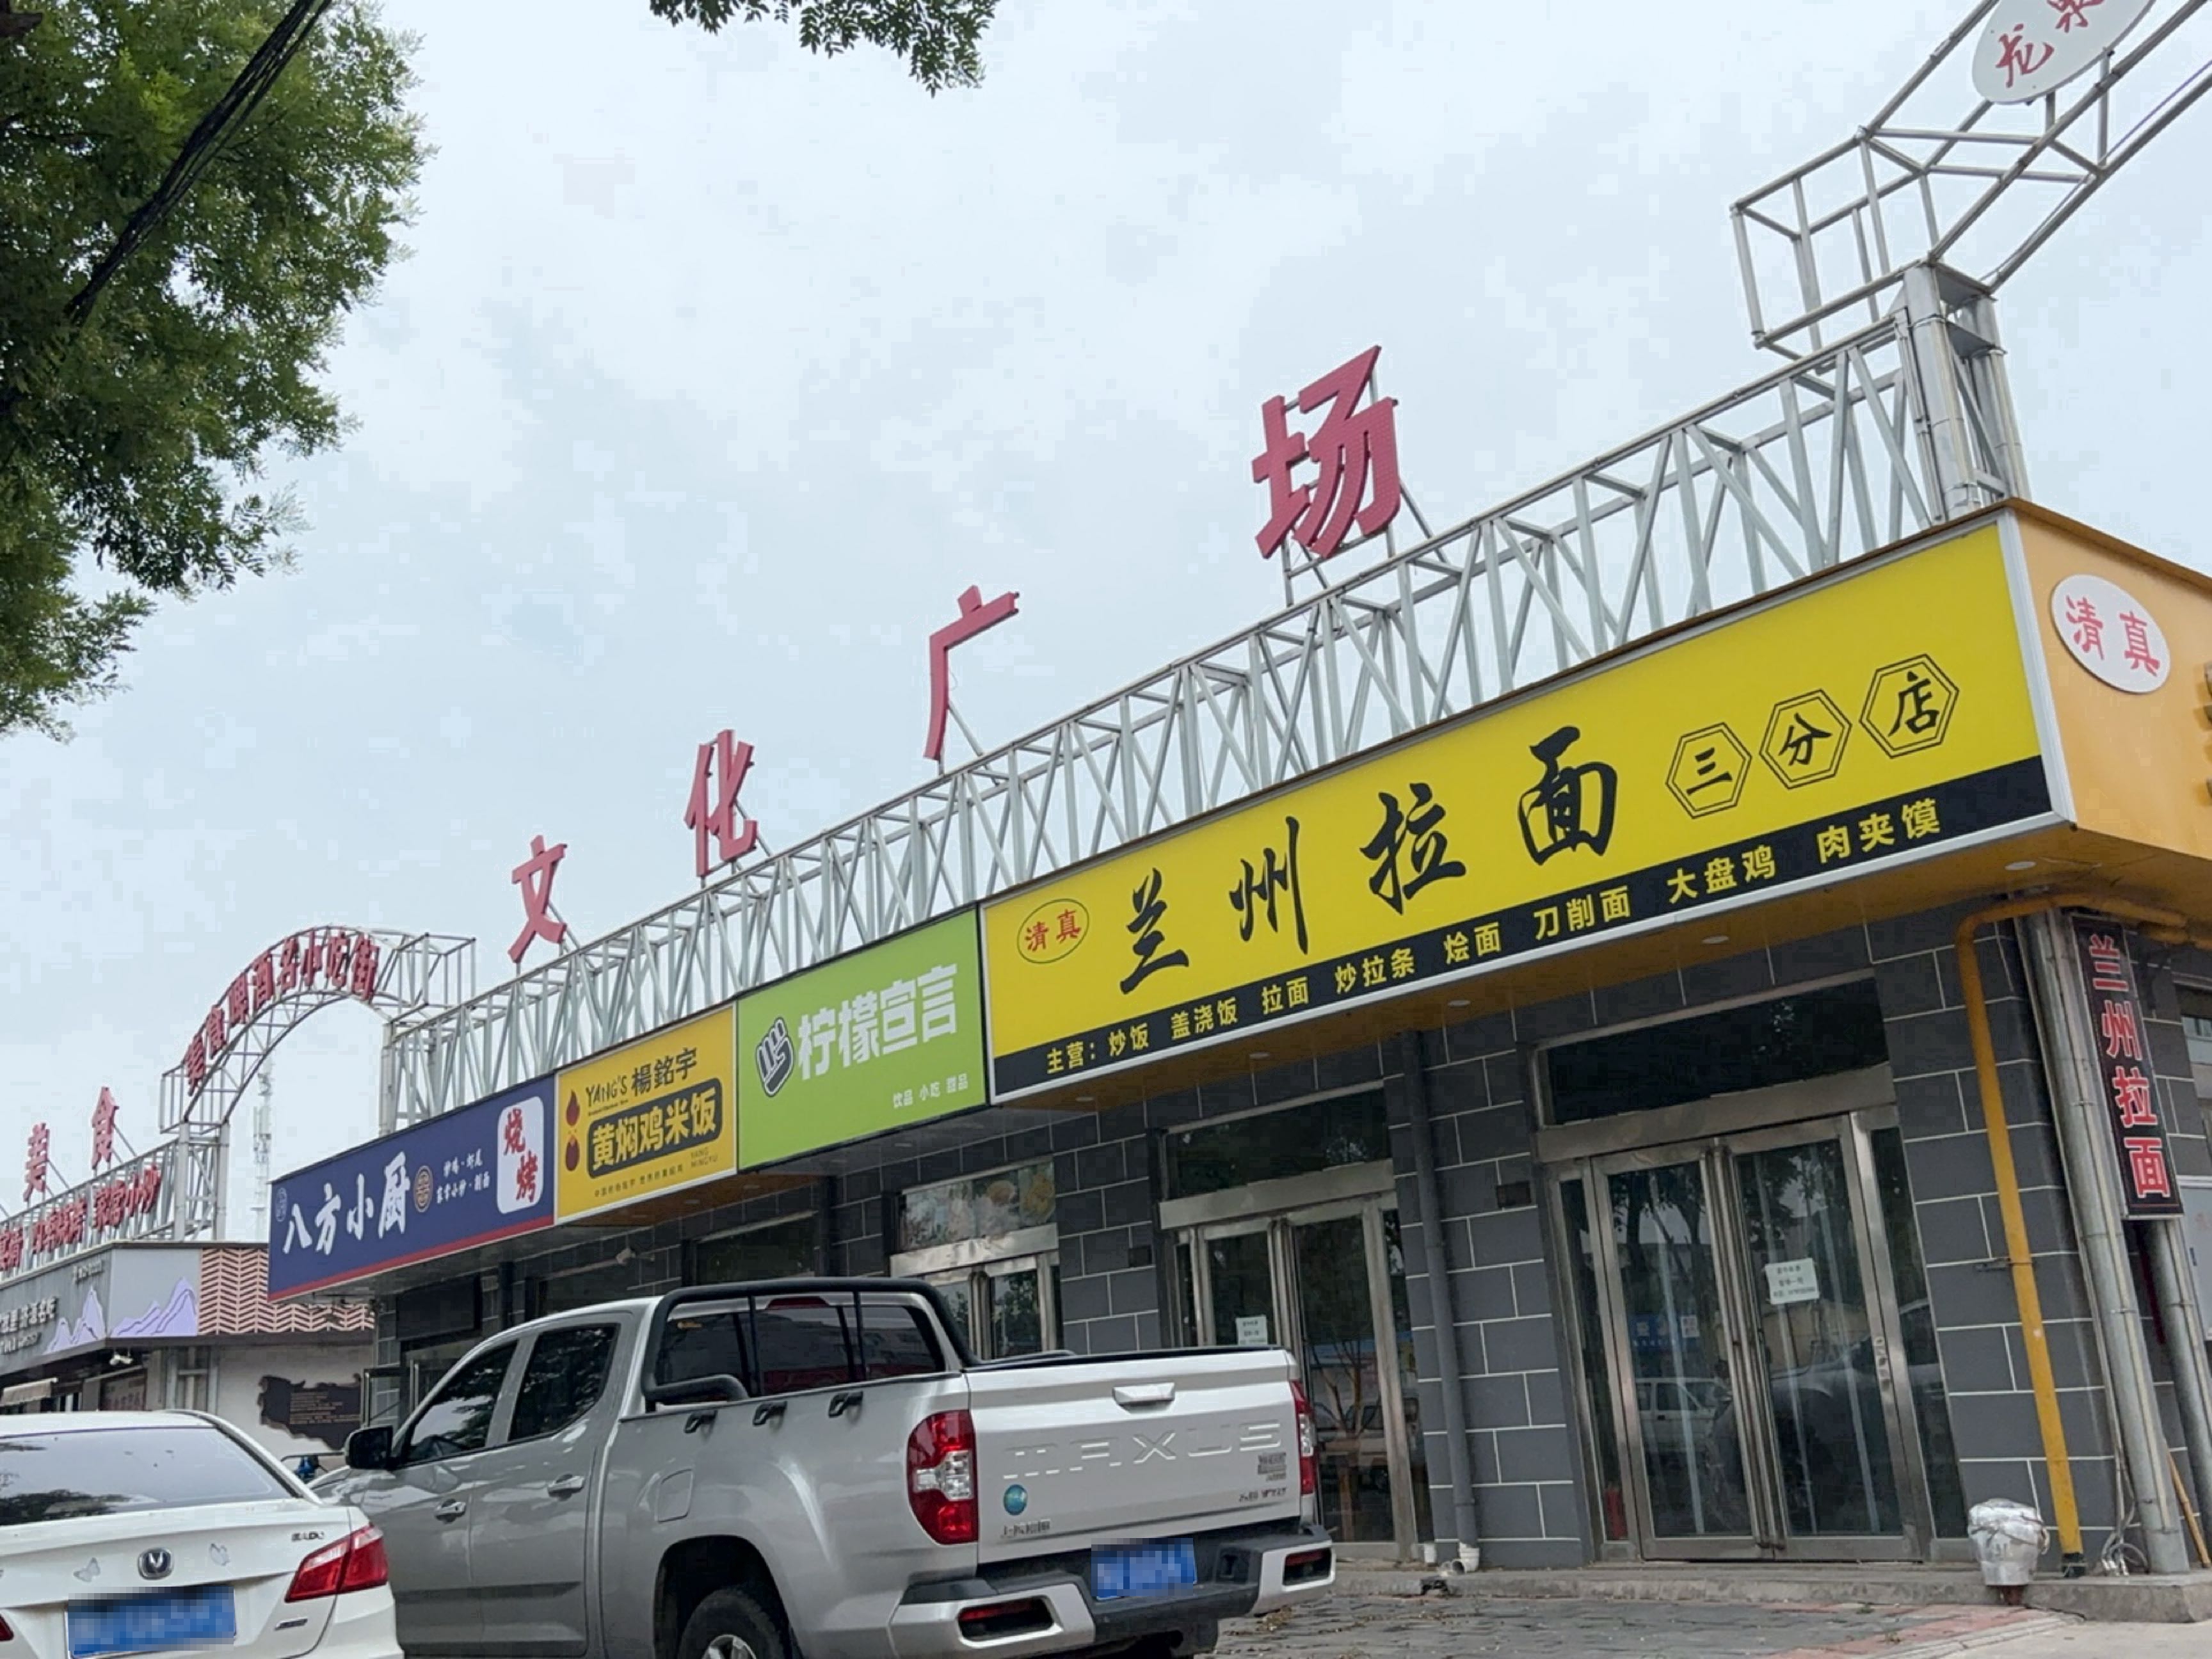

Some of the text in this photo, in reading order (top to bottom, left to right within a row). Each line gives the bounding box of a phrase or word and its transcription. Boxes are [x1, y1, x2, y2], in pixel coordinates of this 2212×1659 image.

[509, 345, 1402, 963] 文化广场
[2065, 595, 2161, 677] 清真
[1686, 671, 1940, 795] 三分店
[1119, 726, 1617, 995] 兰州拉面
[1025, 908, 1081, 952] 清真
[1170, 998, 1237, 1040] 盖浇饭
[1262, 975, 1310, 1014] 拉面
[1334, 947, 1416, 995] 炒拉条
[1443, 921, 1502, 963] 烩面
[1534, 886, 1631, 940] 刀削面
[1667, 846, 1777, 903] 大盘鸡
[1816, 797, 1941, 863] 肉夹馍
[631, 1046, 698, 1097] 楊銘宇
[797, 963, 958, 1081] 柠檬宣言
[2088, 934, 2170, 1198] 兰州拉面
[593, 1086, 716, 1171] 黄焖鸡米饭
[918, 1081, 941, 1101] 小吃
[283, 1152, 411, 1256] 八方小厨
[504, 1107, 538, 1203] 烧烤
